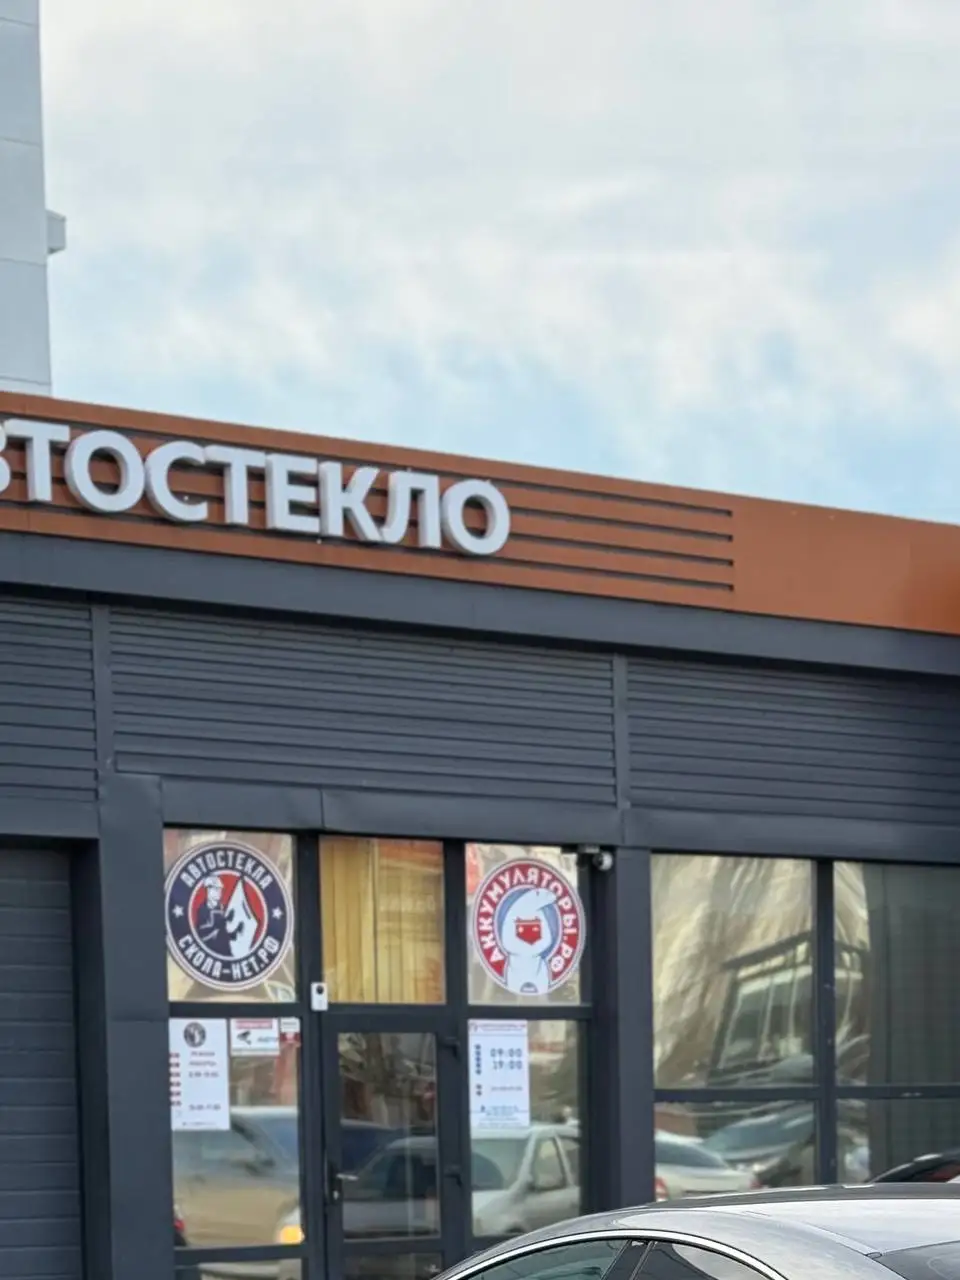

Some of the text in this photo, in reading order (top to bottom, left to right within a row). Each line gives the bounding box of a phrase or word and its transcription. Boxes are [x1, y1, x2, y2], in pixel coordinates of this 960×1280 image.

[0, 418, 511, 556] ТОСТЕКЛО
[180, 850, 273, 890] АВТОСТЕКЛА
[178, 934, 280, 980] СКОЛА-НЕТ.РФ
[479, 867, 577, 973] АККУМУЛЯТОРЫ.РФ
